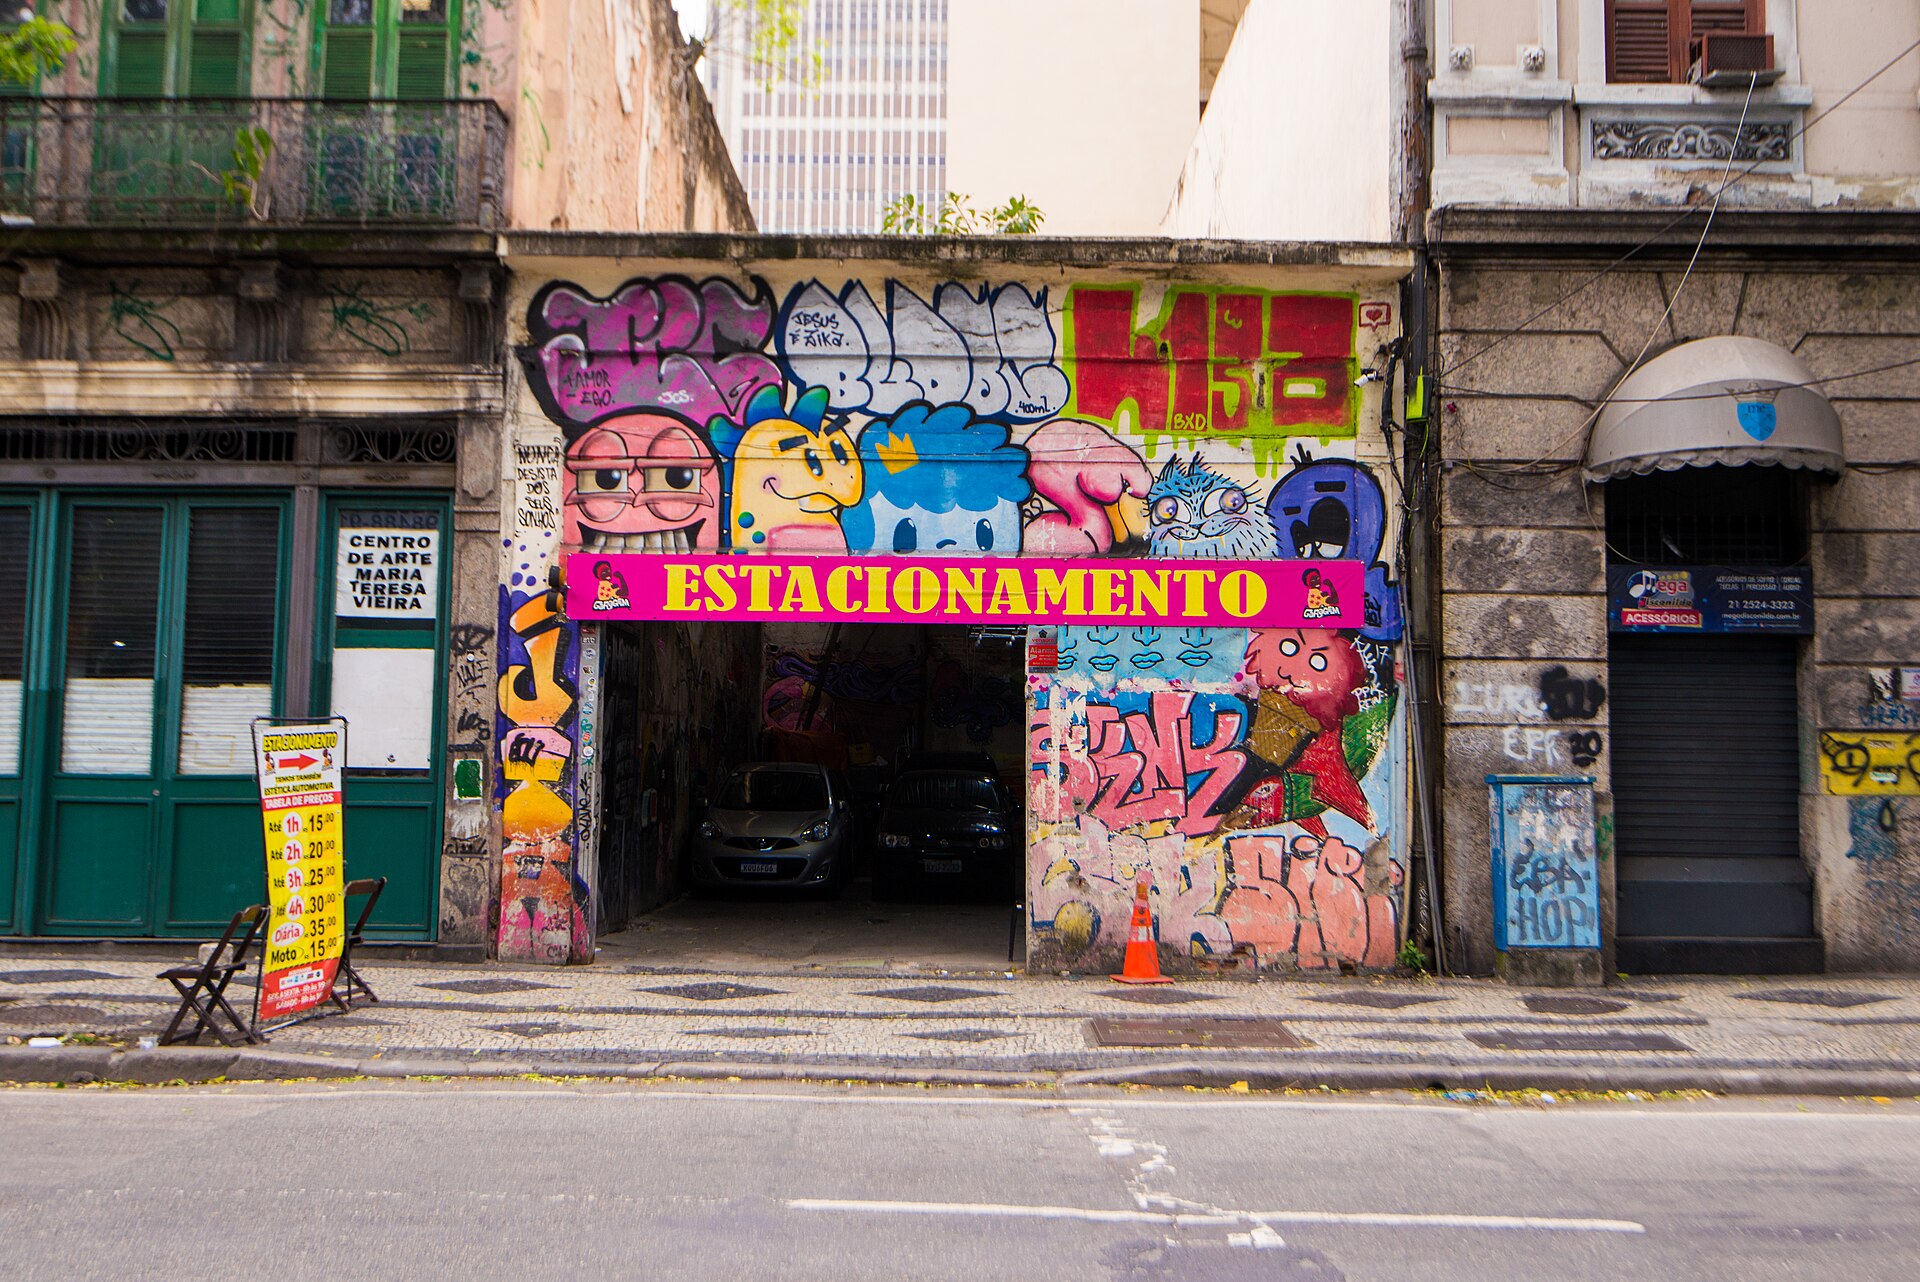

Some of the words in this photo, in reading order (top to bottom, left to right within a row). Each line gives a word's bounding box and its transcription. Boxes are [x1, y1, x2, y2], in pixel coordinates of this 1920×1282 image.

[791, 311, 839, 328] JESUS
[1173, 412, 1207, 431] BXD
[517, 467, 558, 480] DESISTA
[526, 481, 550, 495] DOS
[349, 535, 431, 549] CENTRO
[347, 552, 374, 565] DE
[381, 552, 432, 565] ARTE
[355, 567, 423, 581] MARIA
[349, 580, 427, 596] TERESA
[662, 563, 1269, 618] ESTACIONAMENTO
[353, 595, 422, 610] VIEIRA
[1728, 600, 1740, 609] 21
[1625, 611, 1698, 624] ACESSÓRIOS
[263, 731, 338, 752] ESTACIONAMENTO
[264, 797, 292, 809] TABELA
[292, 795, 304, 807] DE
[303, 792, 335, 805] PREÇOS
[268, 820, 282, 833] Até
[286, 815, 300, 833] 1h
[271, 847, 283, 861] Até
[286, 843, 301, 861] 2h
[273, 875, 285, 888] Até
[288, 871, 302, 888] 3h
[289, 898, 303, 916] 4h
[270, 947, 297, 966] Moto
